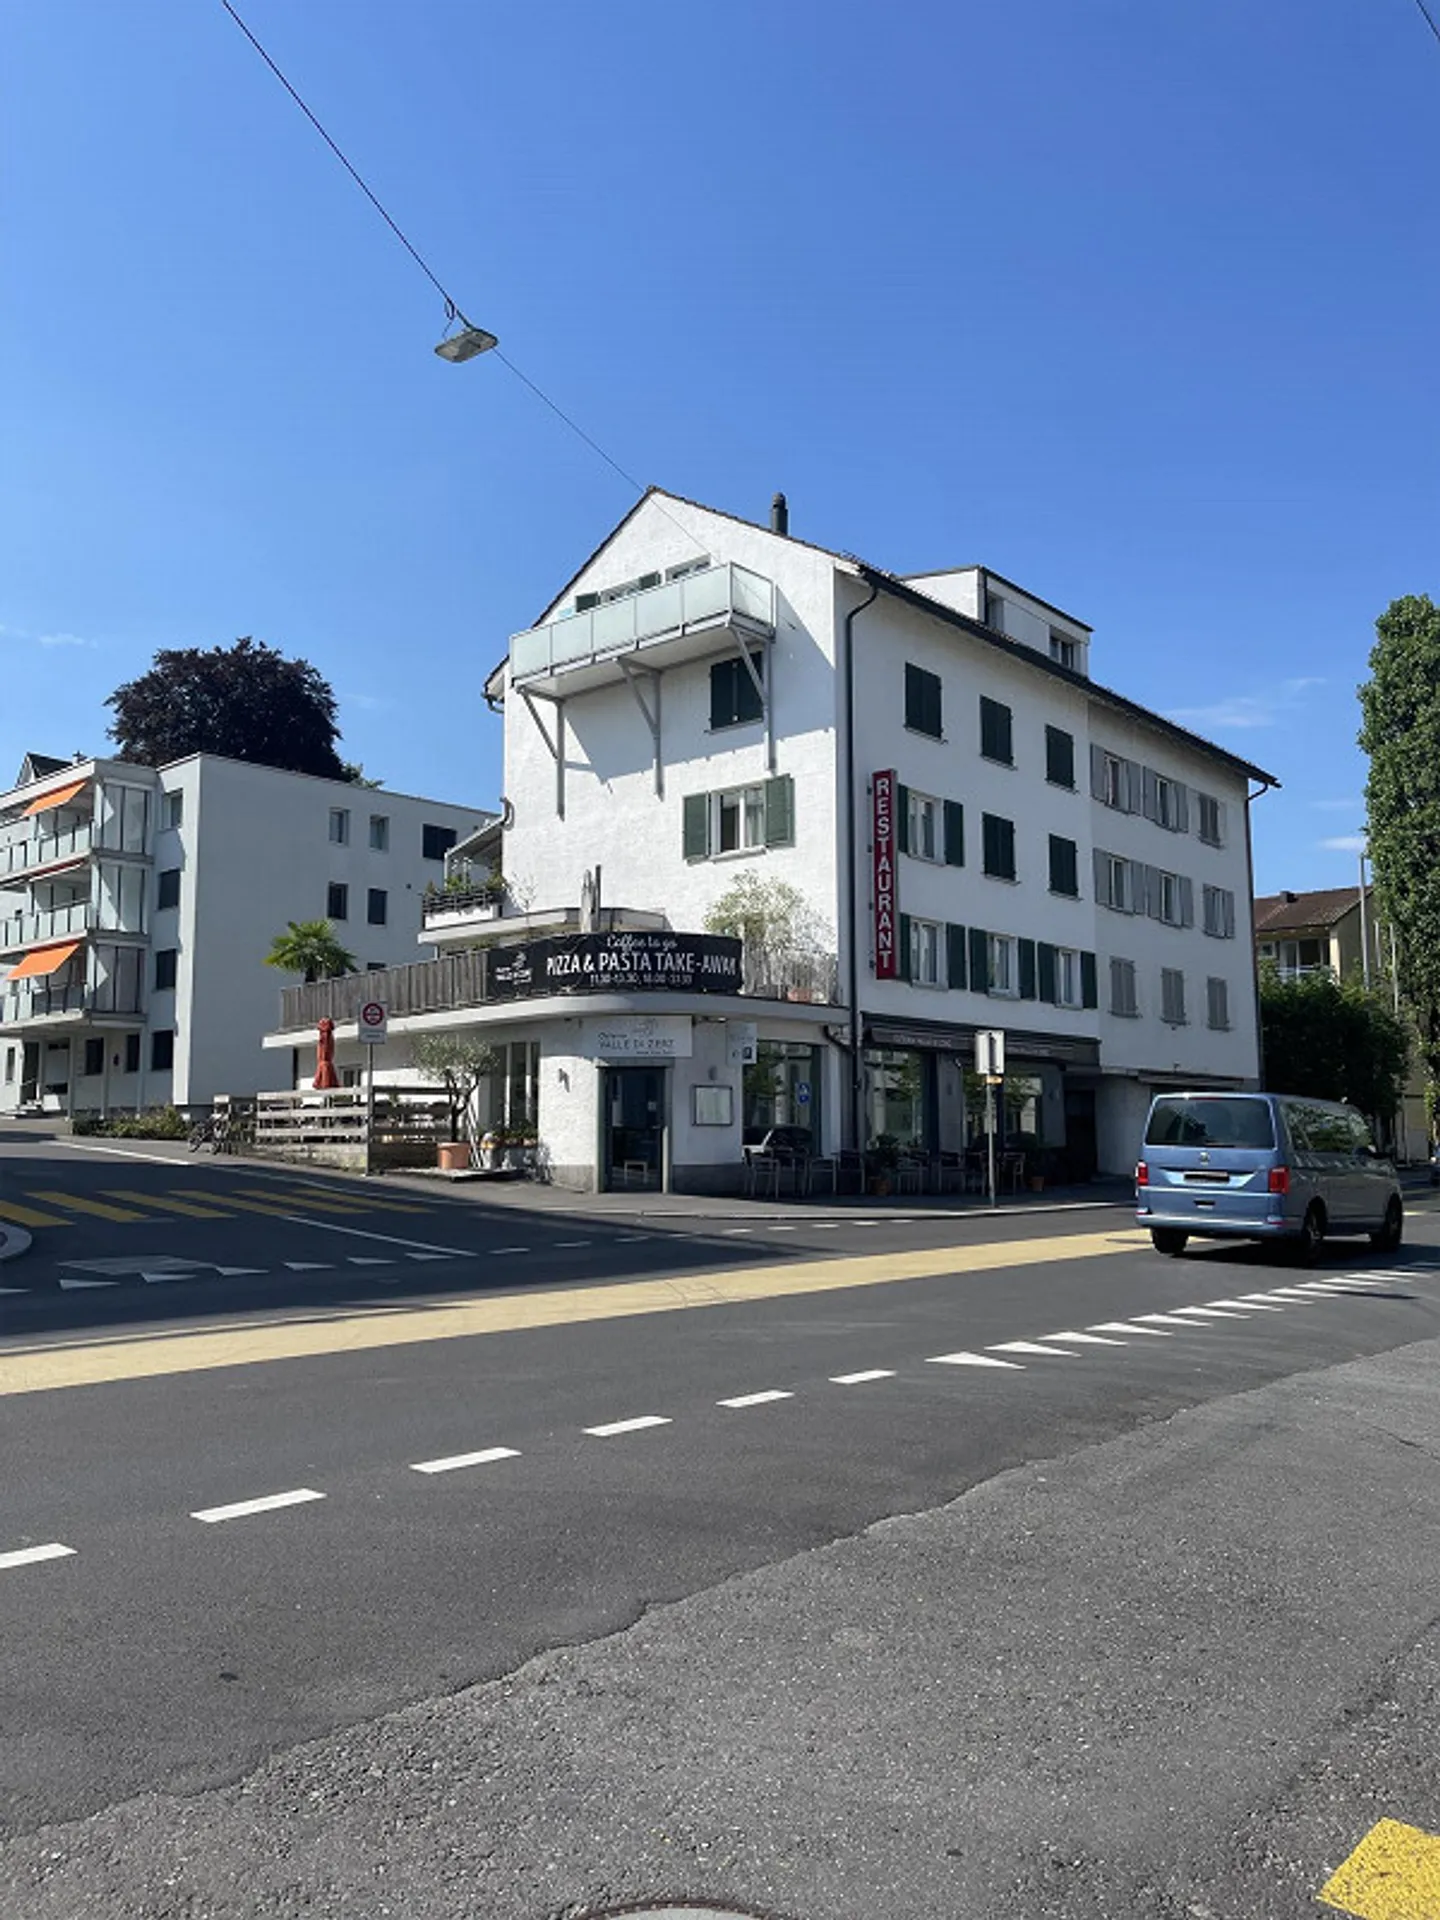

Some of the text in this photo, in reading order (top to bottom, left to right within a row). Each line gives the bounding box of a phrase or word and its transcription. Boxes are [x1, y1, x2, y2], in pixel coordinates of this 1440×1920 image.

[875, 777, 893, 969] RESTAURANT
[606, 934, 646, 951] Coffee
[546, 953, 581, 976] PIZZA
[583, 953, 595, 972] &
[598, 952, 652, 972] PASTA
